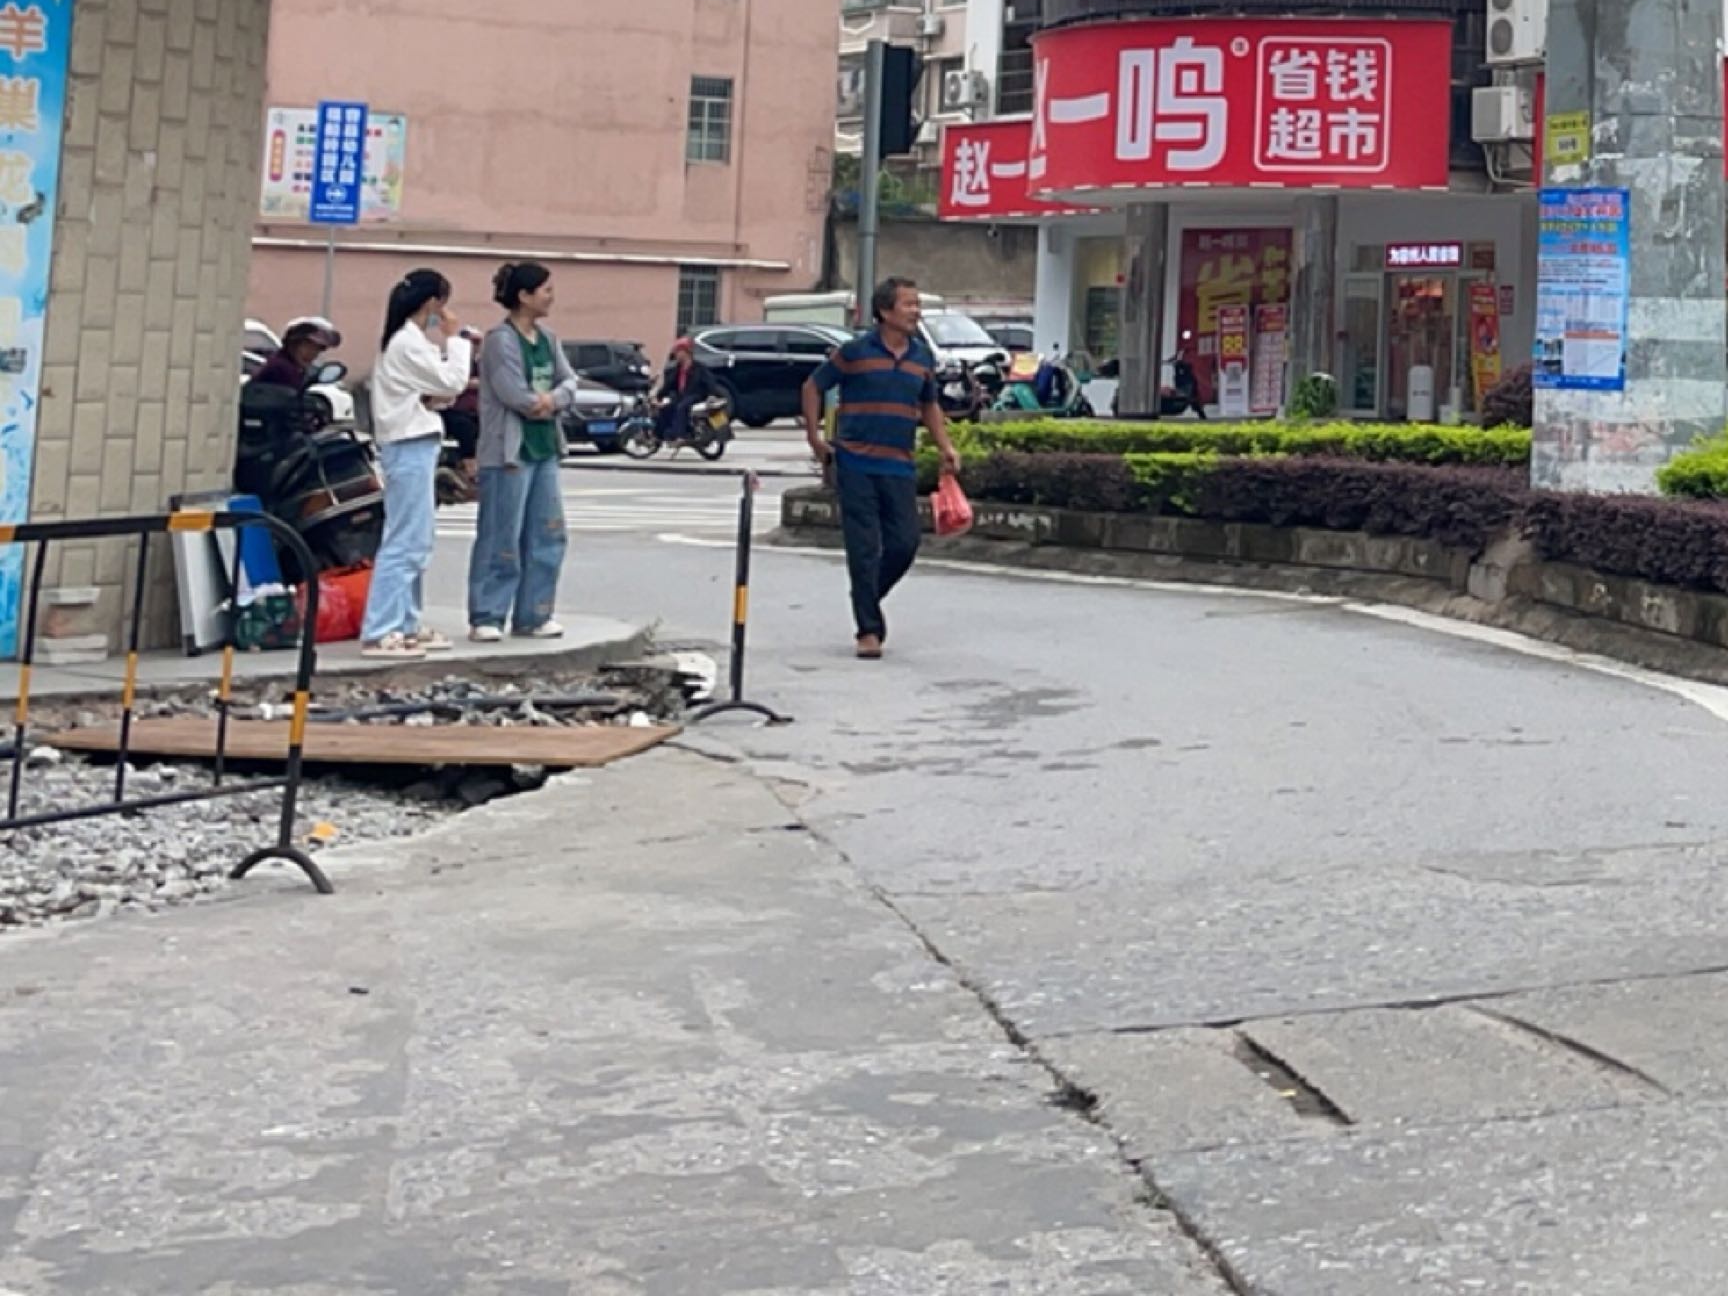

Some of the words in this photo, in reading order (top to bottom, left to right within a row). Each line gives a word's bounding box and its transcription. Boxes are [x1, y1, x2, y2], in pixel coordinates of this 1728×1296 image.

[1268, 49, 1379, 103] 省钱
[1032, 37, 1228, 172] 一鸣
[1268, 107, 1381, 161] 超市
